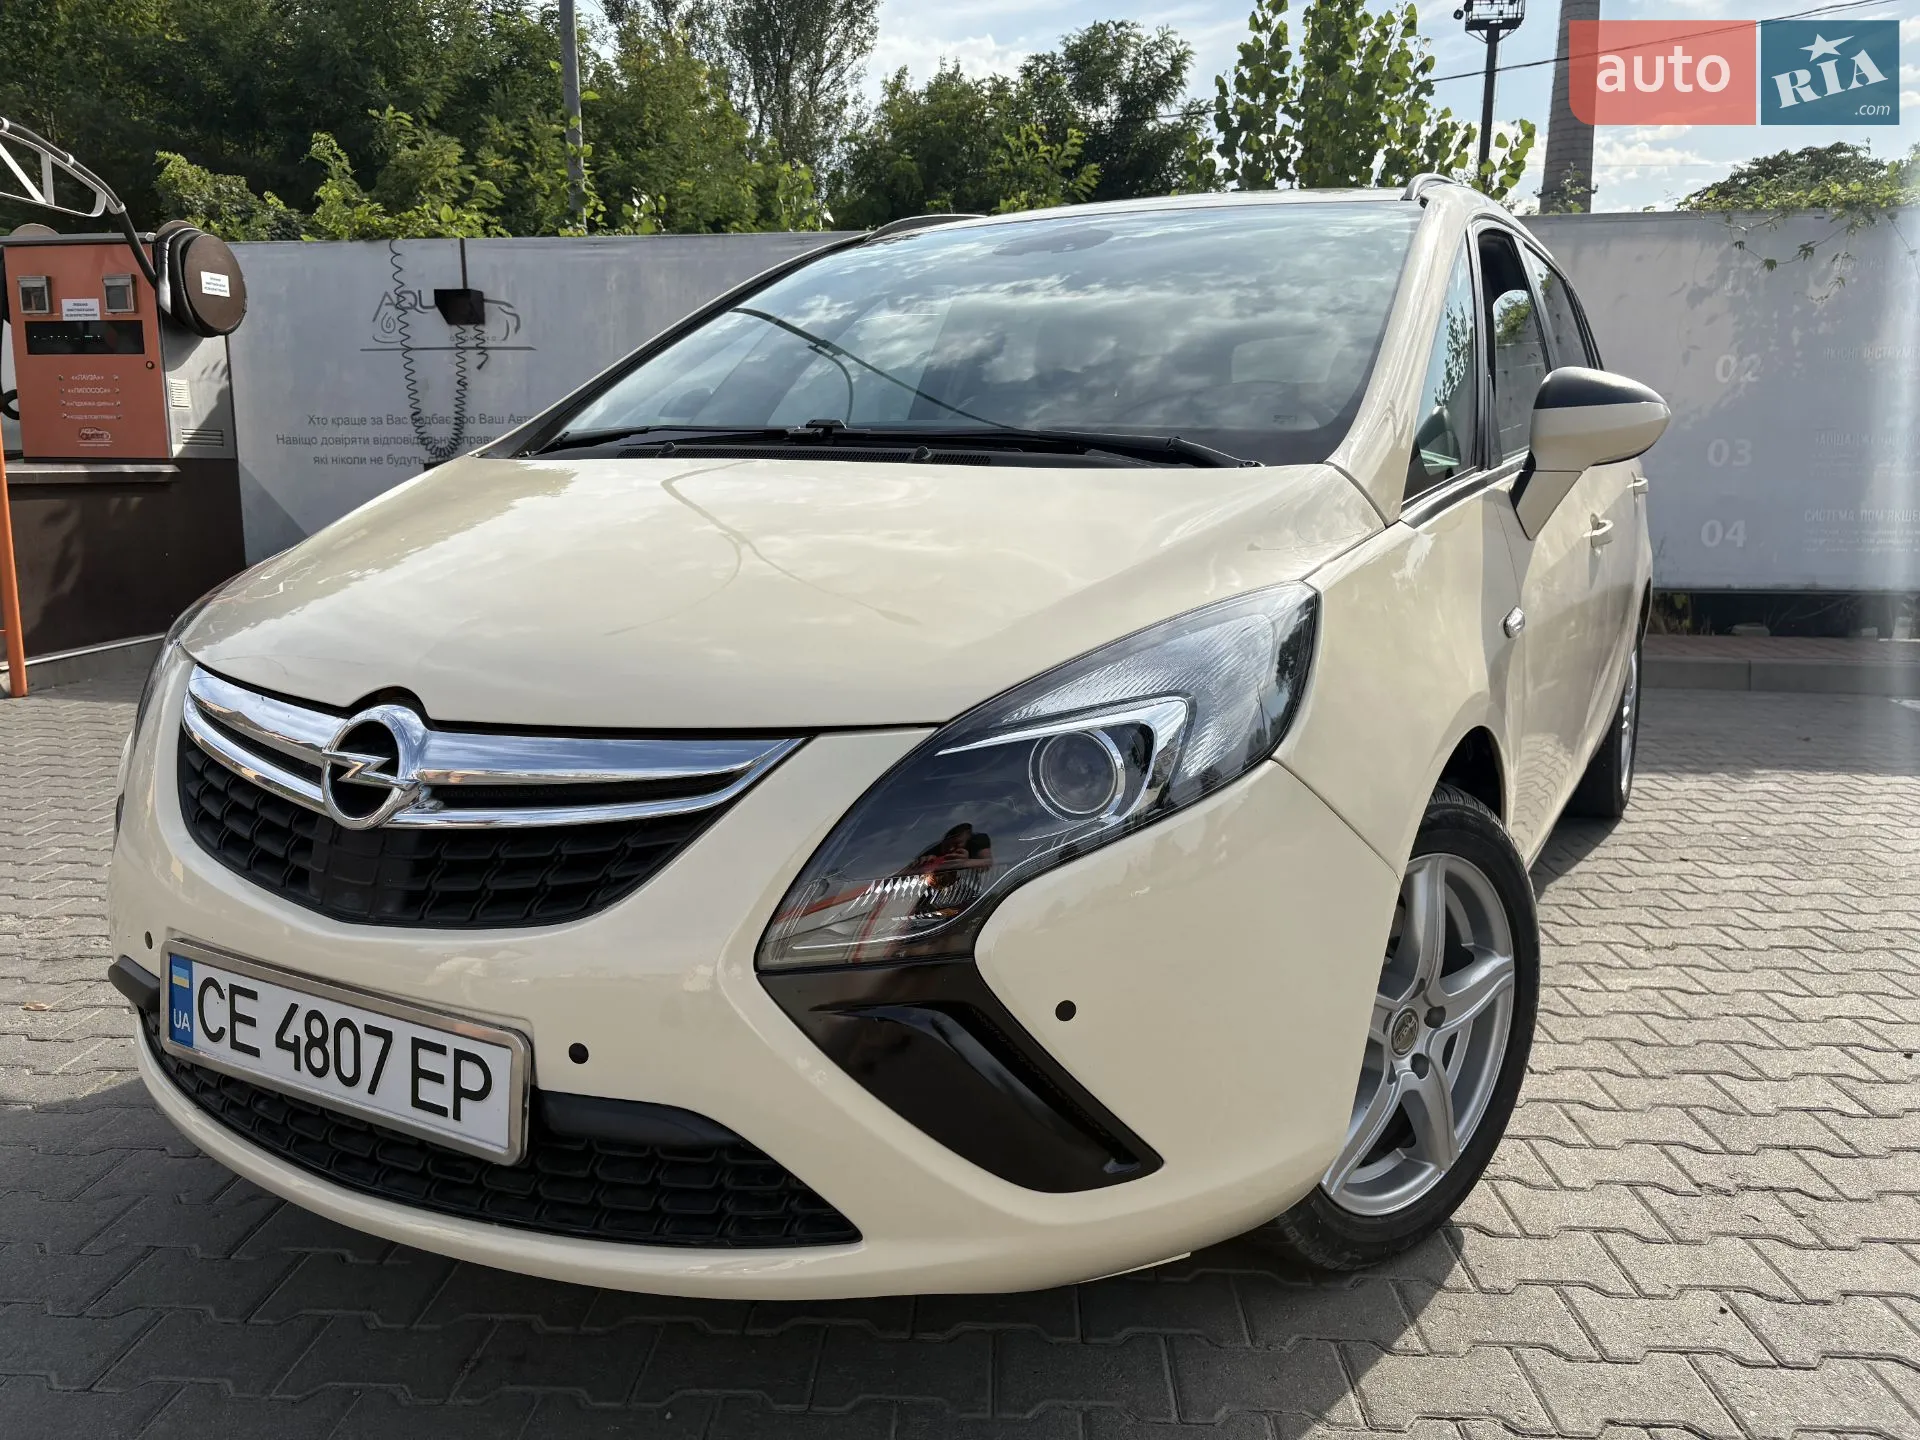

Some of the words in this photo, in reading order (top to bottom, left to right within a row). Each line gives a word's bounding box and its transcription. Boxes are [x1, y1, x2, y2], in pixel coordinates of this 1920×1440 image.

[1715, 355, 1760, 383] 02
[307, 414, 328, 426] Хто
[331, 416, 367, 428] краще
[370, 416, 383, 426] за
[386, 414, 409, 425] Вас
[479, 413, 504, 424] Ваш
[276, 434, 318, 448] Навіщо
[320, 435, 370, 447] довіряти
[1707, 439, 1752, 467] 03
[313, 455, 328, 465] які
[331, 455, 367, 465] ніколи
[370, 456, 384, 465] не
[1700, 519, 1747, 548] 04
[173, 1008, 191, 1032] UA
[197, 977, 260, 1058] CE
[275, 1002, 394, 1096] 4807
[410, 1036, 493, 1122] EP
